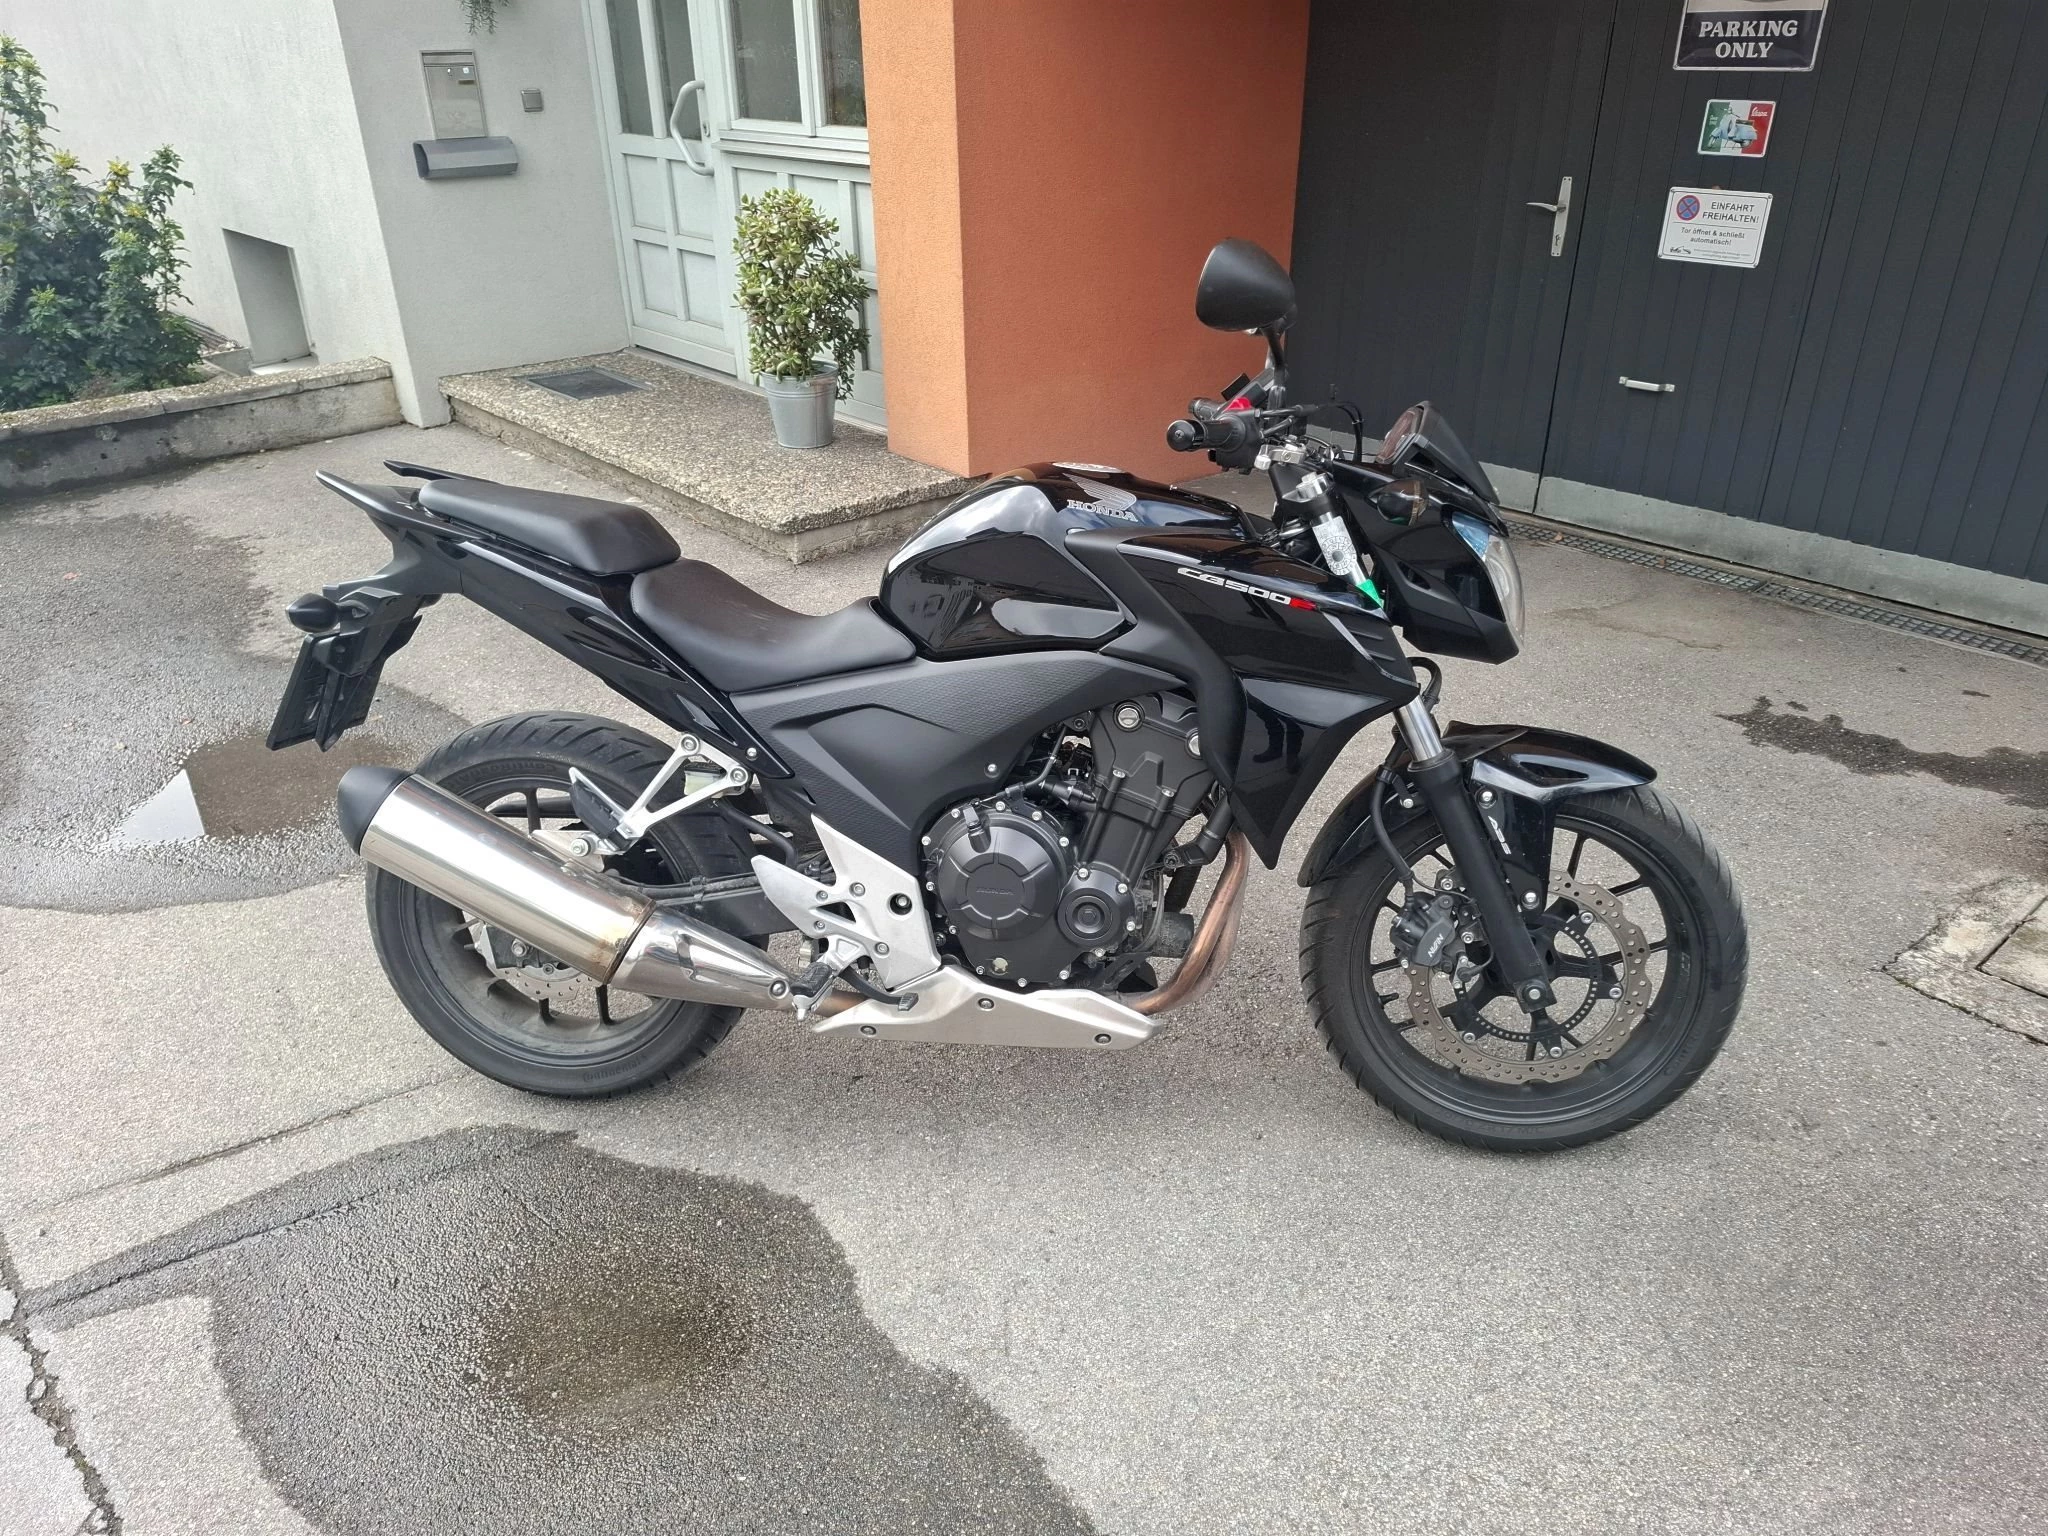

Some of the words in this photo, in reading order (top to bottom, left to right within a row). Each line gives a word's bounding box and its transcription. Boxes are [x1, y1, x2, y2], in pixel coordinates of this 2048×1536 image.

[1698, 19, 1798, 38] PARKING
[1715, 42, 1774, 58] ONLY
[1711, 202, 1755, 212] EINFAHRT
[1702, 212, 1760, 223] FREIHALTEN!
[1692, 227, 1711, 236] öffnet
[1719, 231, 1745, 239] schließt
[1690, 237, 1732, 246] automatisch!
[1067, 499, 1138, 522] HONDA
[1487, 815, 1512, 855] ABS
